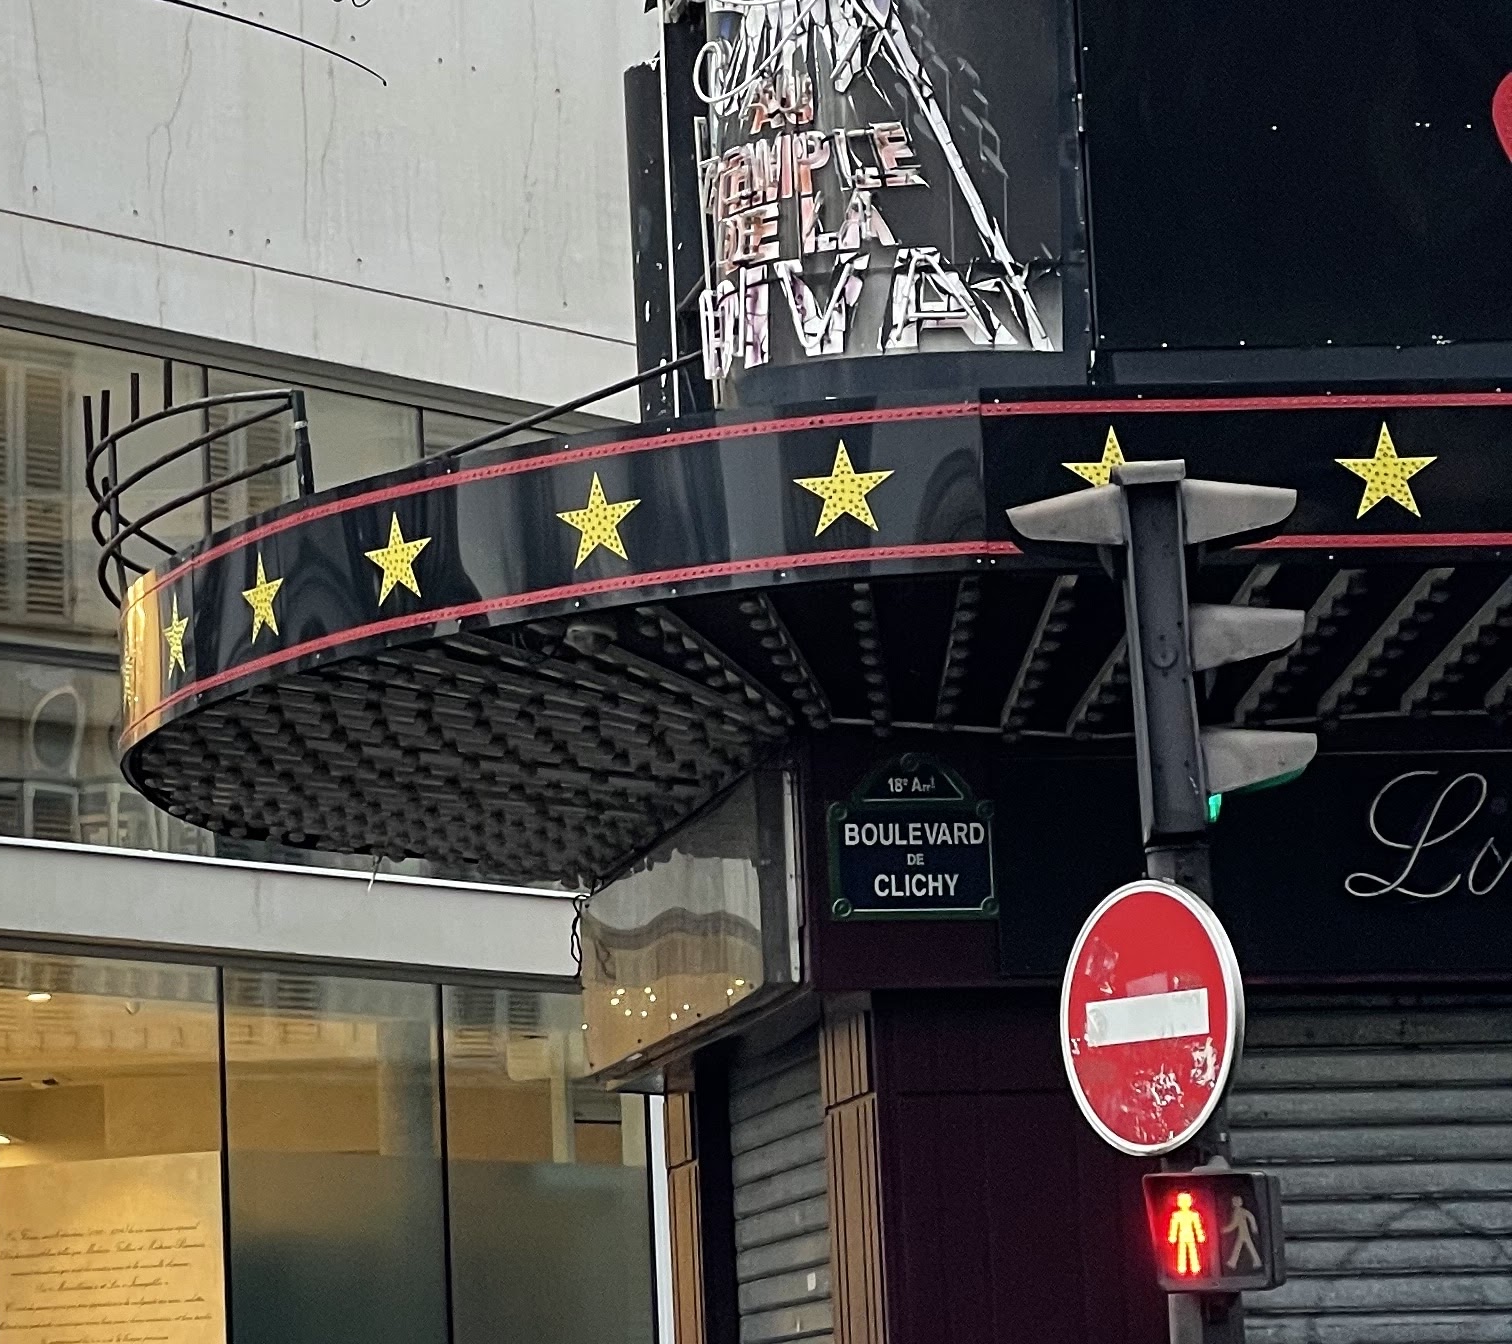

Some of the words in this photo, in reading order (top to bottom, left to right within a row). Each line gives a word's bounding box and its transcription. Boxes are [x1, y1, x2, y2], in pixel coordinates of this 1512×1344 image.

[802, 189, 900, 254] LA
[844, 822, 985, 846] BOULEVARD
[907, 853, 925, 866] DE
[874, 873, 959, 897] CLICHY
